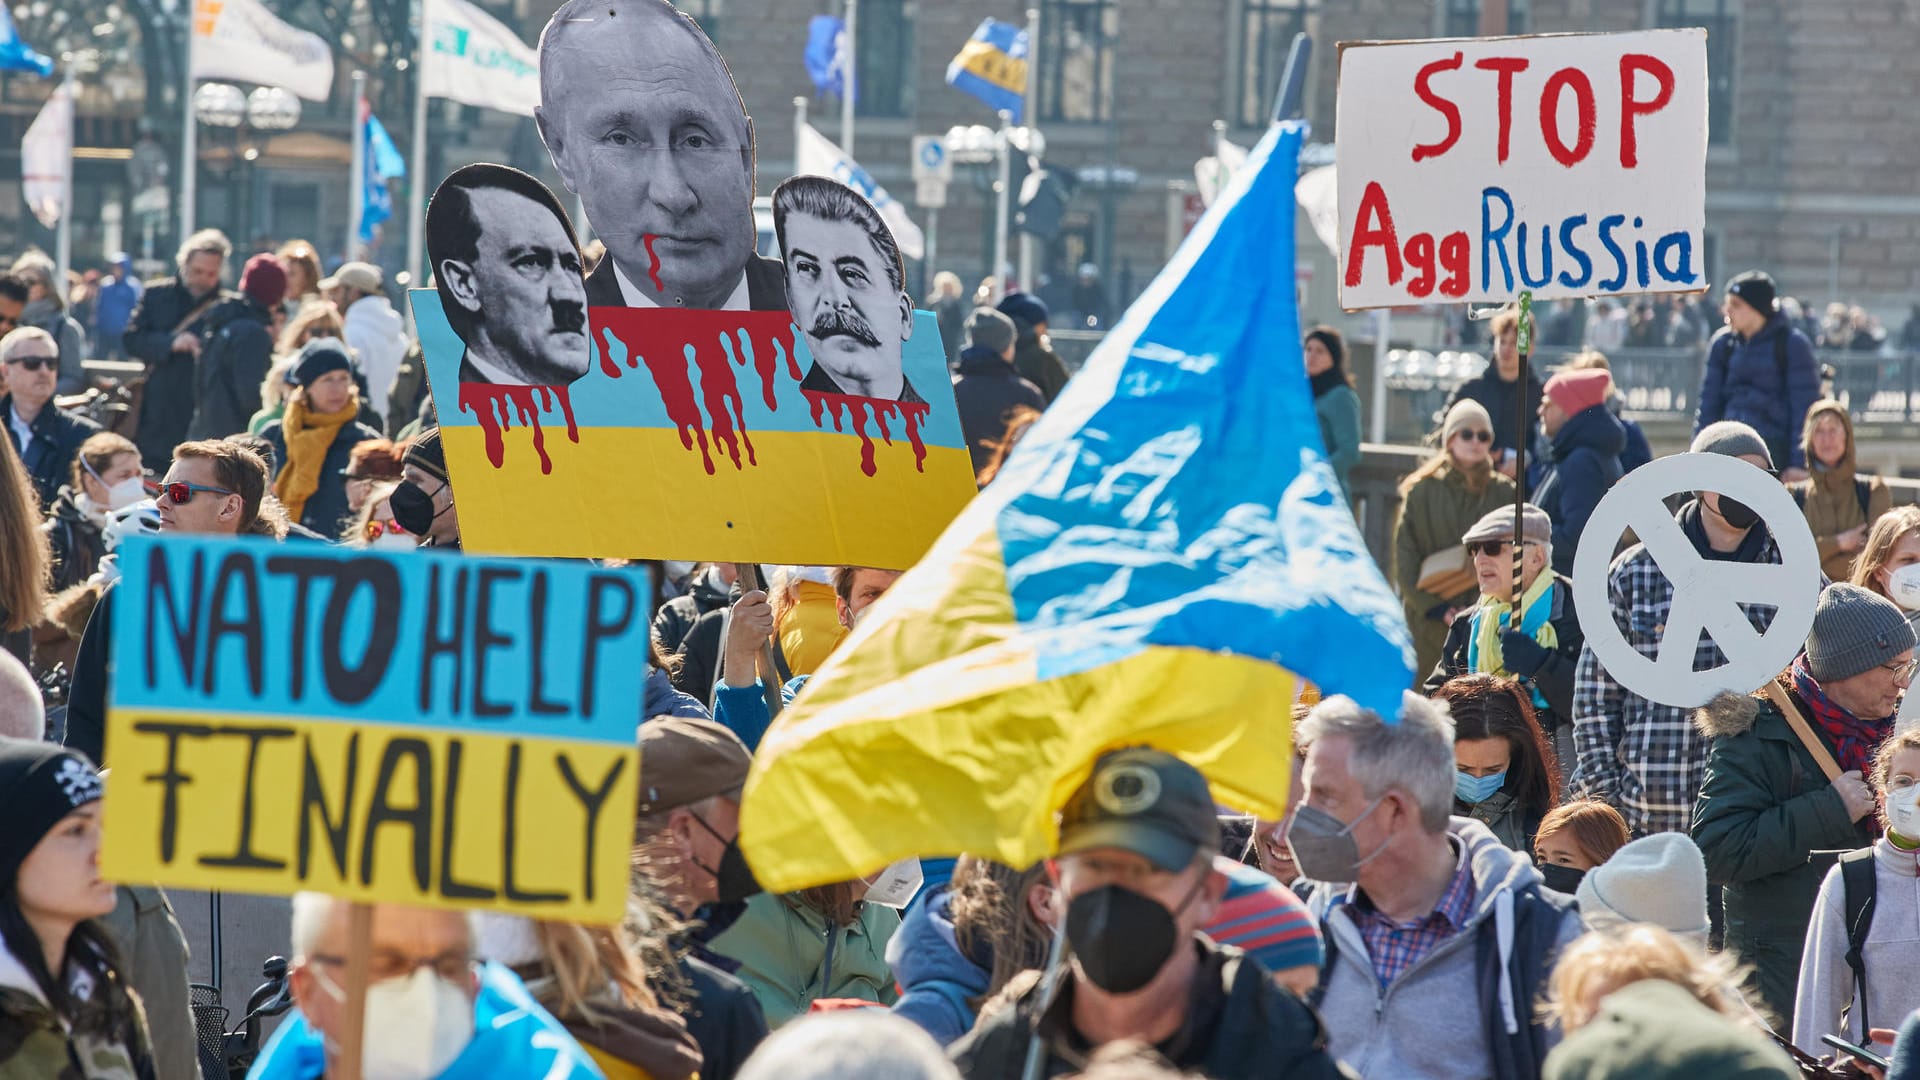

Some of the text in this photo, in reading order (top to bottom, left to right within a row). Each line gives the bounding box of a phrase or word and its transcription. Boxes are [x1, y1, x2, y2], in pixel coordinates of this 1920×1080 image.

[1411, 51, 1675, 169] STOP
[146, 546, 636, 719] NATO HELP
[133, 722, 628, 904] FINALLY
